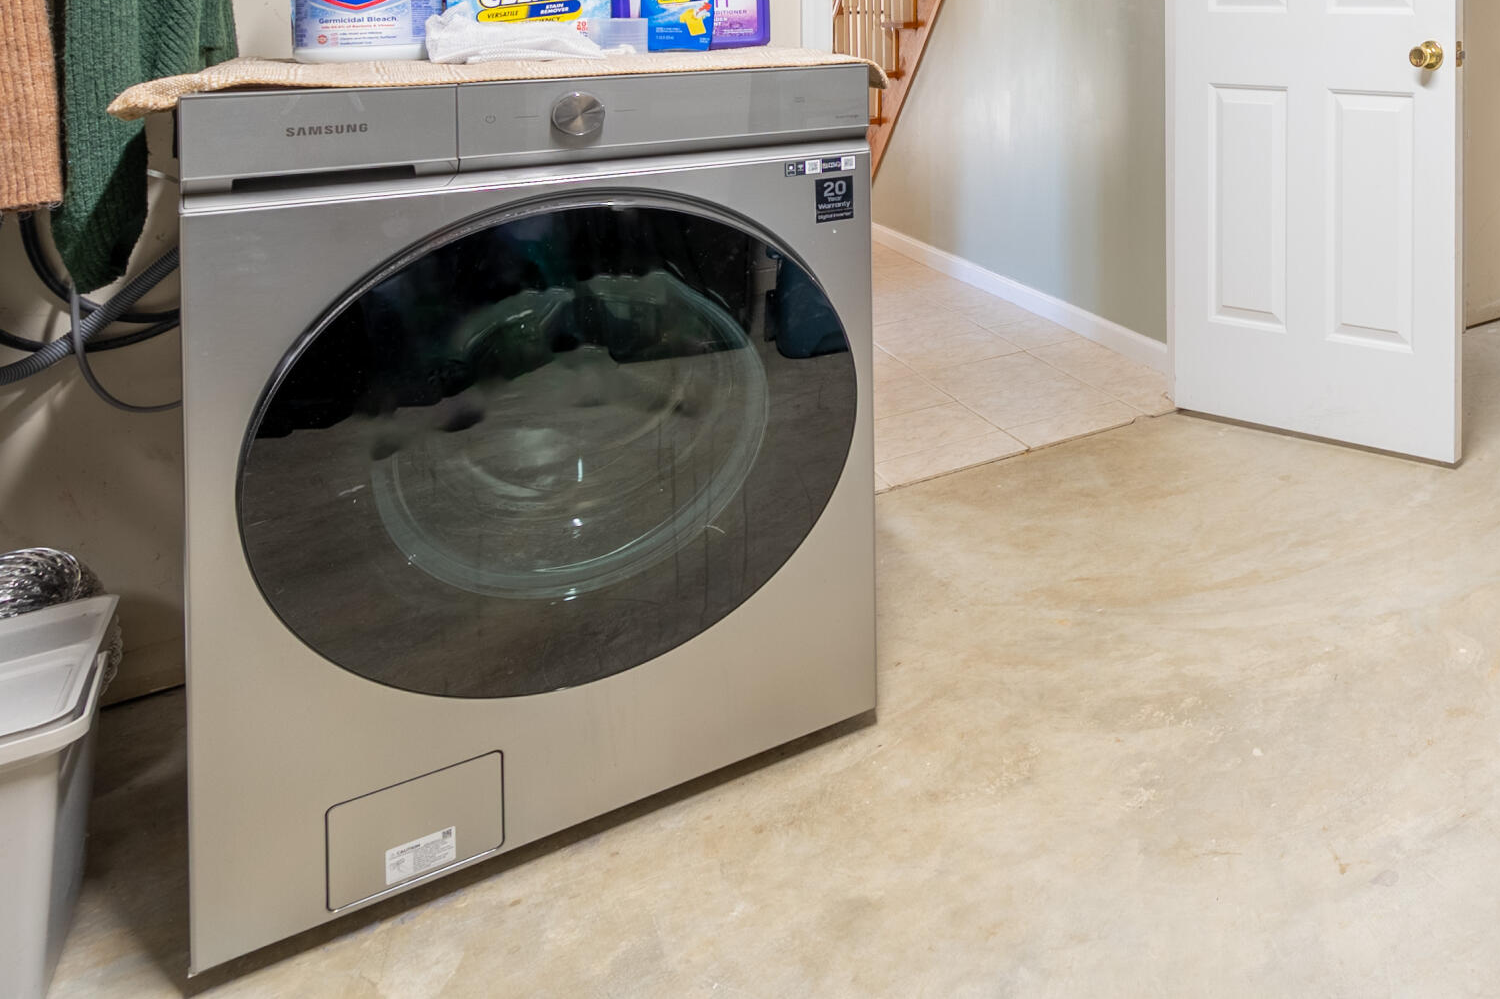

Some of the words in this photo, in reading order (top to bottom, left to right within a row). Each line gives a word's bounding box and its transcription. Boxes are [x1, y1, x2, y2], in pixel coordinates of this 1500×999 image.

[487, 10, 519, 19] VERSATILE
[540, 6, 569, 14] REMOVER
[318, 16, 364, 24] Germicidal
[286, 123, 368, 137] SAMSUNG
[823, 180, 847, 197] 20
[818, 201, 851, 210] Warranty
